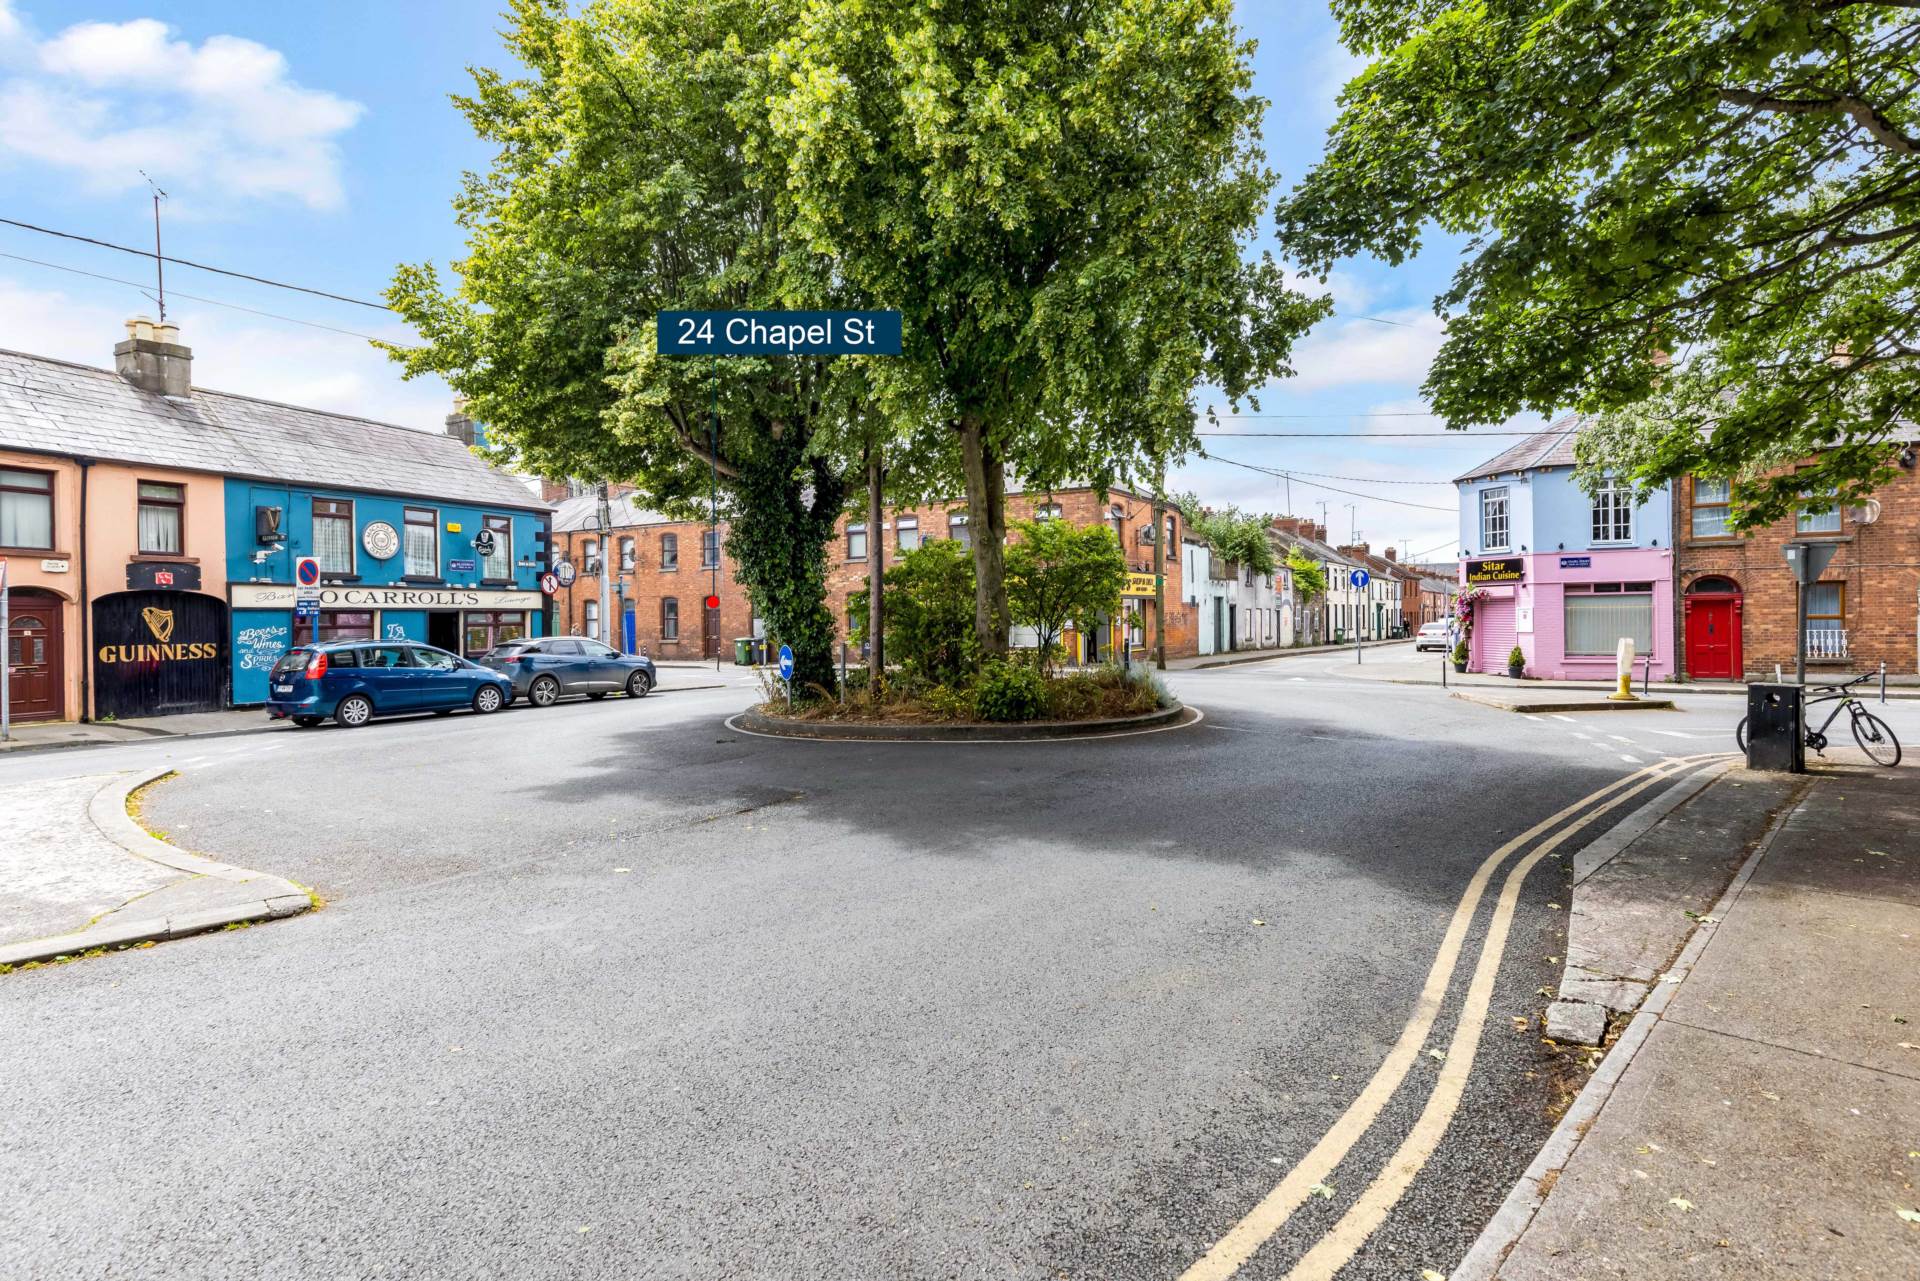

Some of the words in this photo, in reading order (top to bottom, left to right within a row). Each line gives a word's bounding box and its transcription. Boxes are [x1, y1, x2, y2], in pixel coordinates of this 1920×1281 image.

[1482, 561, 1505, 571] Sitar
[1469, 572, 1491, 581] Indian
[1492, 570, 1520, 580] Cuisine
[238, 626, 288, 644] Beers
[253, 637, 286, 649] Wines
[99, 643, 218, 663] GUINNESS
